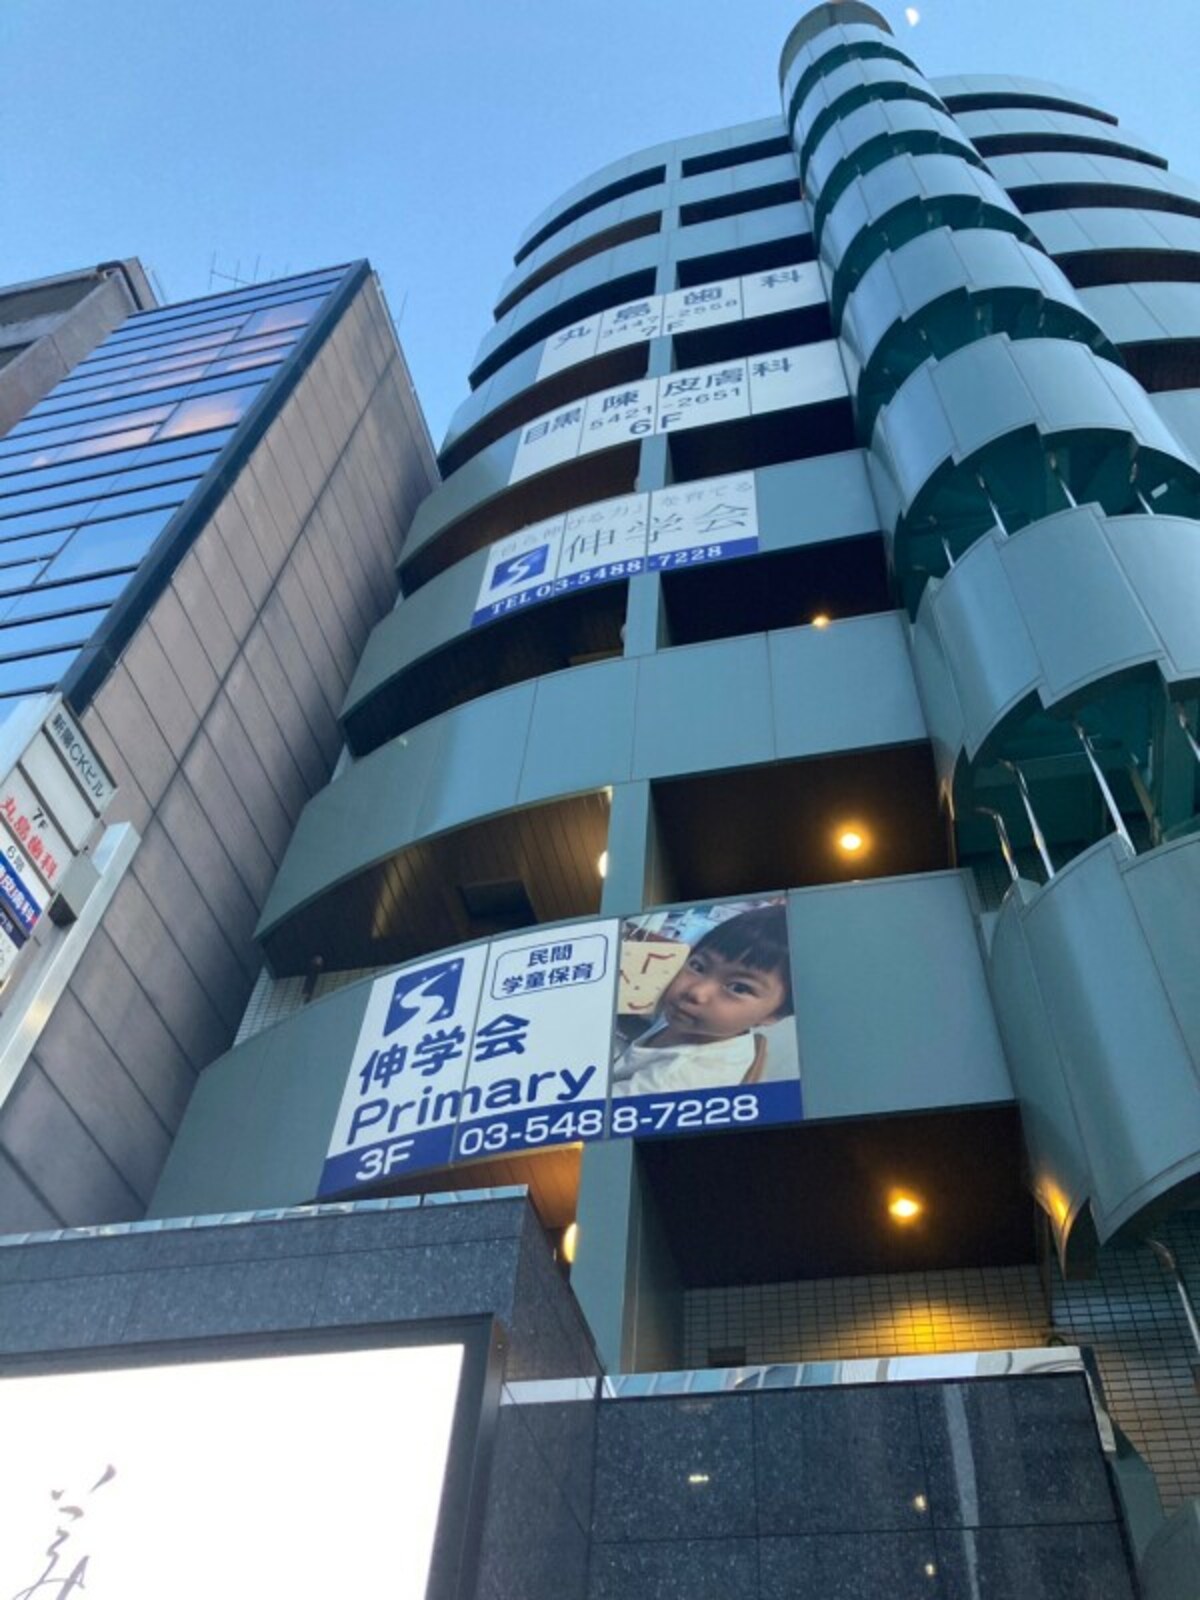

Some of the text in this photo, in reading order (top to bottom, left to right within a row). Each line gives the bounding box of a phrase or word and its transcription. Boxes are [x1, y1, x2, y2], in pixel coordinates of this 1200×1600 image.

[629, 412, 682, 435] 6F
[568, 503, 748, 563] 伸学会
[490, 545, 723, 615] TEL 03-5488-7228
[502, 962, 594, 995] 学童保育
[527, 944, 573, 969] 民間
[360, 1014, 530, 1096] 伸学会
[347, 1065, 597, 1146] Primary
[355, 1095, 760, 1181] 3F 03-5488-7228
